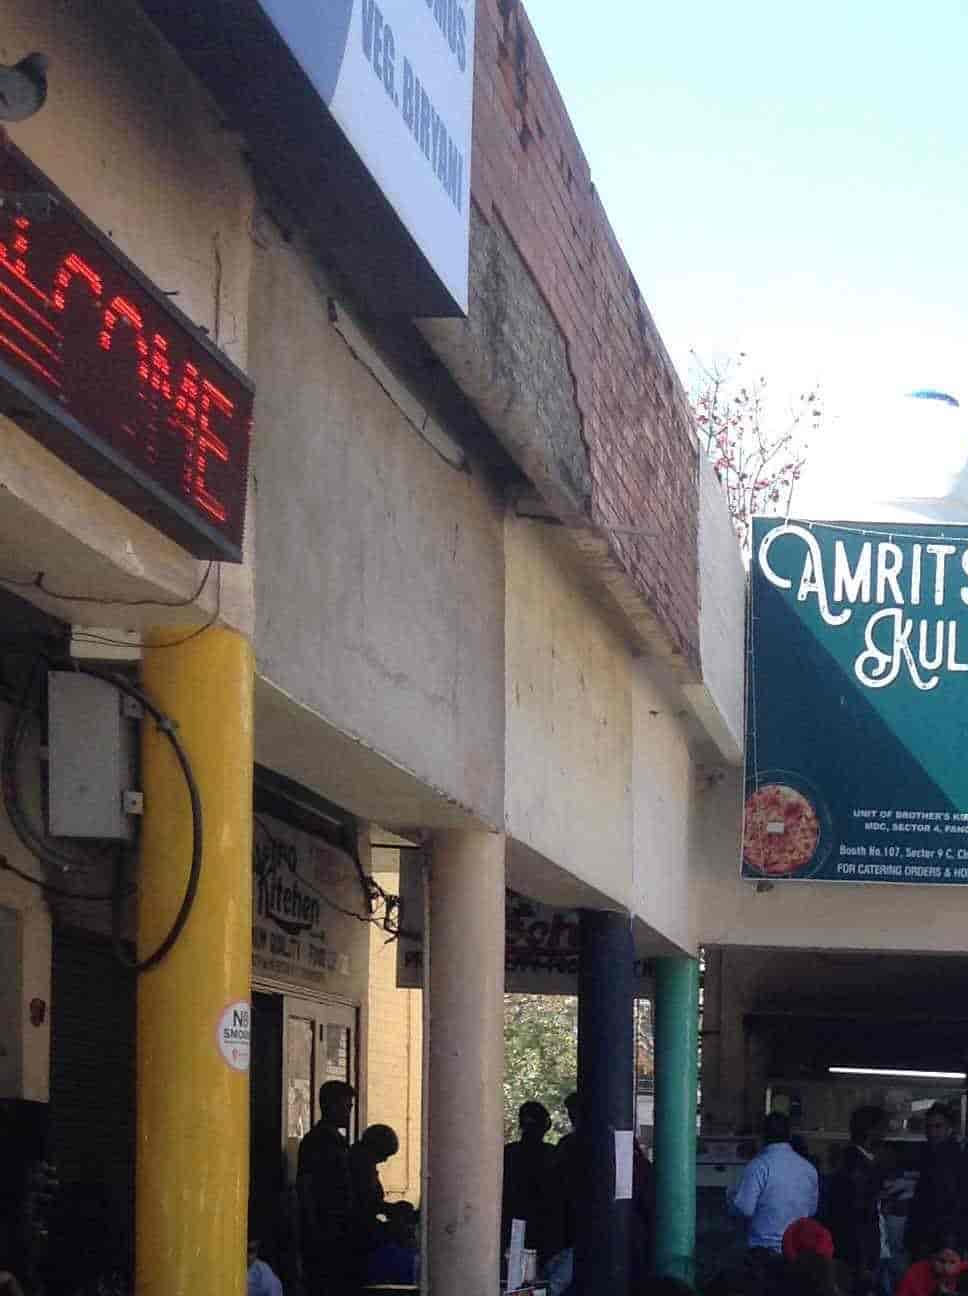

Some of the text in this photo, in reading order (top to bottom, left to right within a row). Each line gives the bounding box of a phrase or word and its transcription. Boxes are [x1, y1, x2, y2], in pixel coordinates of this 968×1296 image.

[402, 56, 464, 216] BIRYANI
[852, 809, 878, 819] UNIT
[879, 810, 893, 819] OF
[891, 823, 931, 833] SECTOR
[839, 844, 867, 857] Booth
[905, 847, 935, 859] Sector
[836, 862, 857, 875] FOR
[857, 863, 903, 876] CATERING
[904, 864, 942, 878] ORDERS
